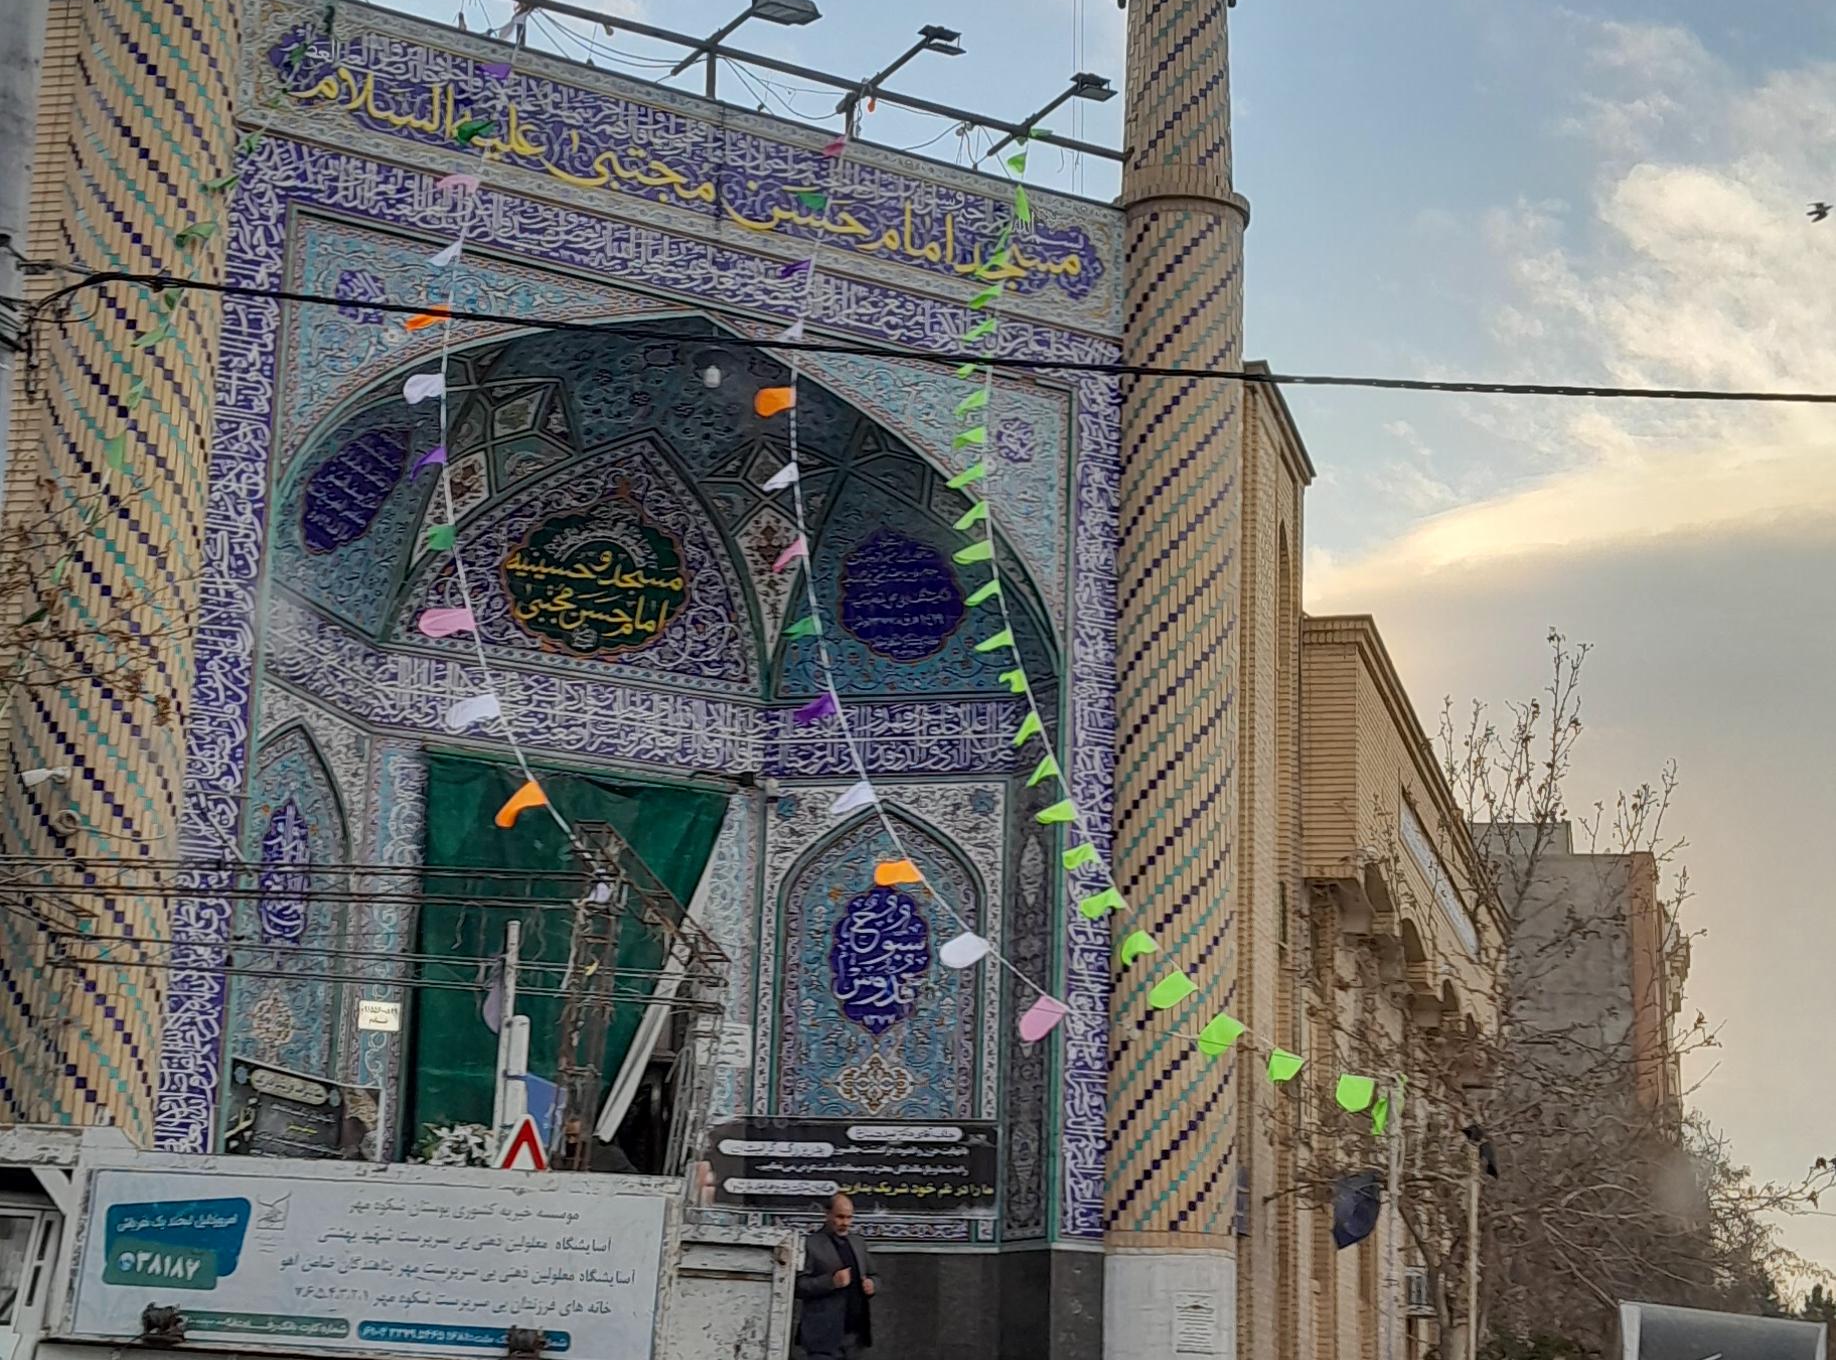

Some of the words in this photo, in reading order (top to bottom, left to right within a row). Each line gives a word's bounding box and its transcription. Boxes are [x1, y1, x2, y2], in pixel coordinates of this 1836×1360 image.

[287, 66, 458, 140] السلام
[537, 128, 716, 204] مجتبی
[720, 179, 872, 237] حسن
[854, 200, 954, 266] امام
[954, 241, 1082, 290] مسجد
[504, 550, 598, 578] حسینیه
[597, 564, 685, 591] مسجد
[514, 583, 578, 622] مجتبی
[558, 606, 633, 630] حسن
[601, 594, 669, 638] امام
[873, 1181, 910, 1196] شریک
[910, 1182, 937, 1197] خود
[954, 1184, 969, 1197] در
[969, 1183, 981, 1197] را
[982, 1183, 995, 1194] ما
[452, 1202, 498, 1220] کشوری
[500, 1205, 533, 1222] خیریه
[536, 1209, 580, 1225] موسسه
[558, 1300, 584, 1317] های
[587, 1299, 612, 1315] خانه
